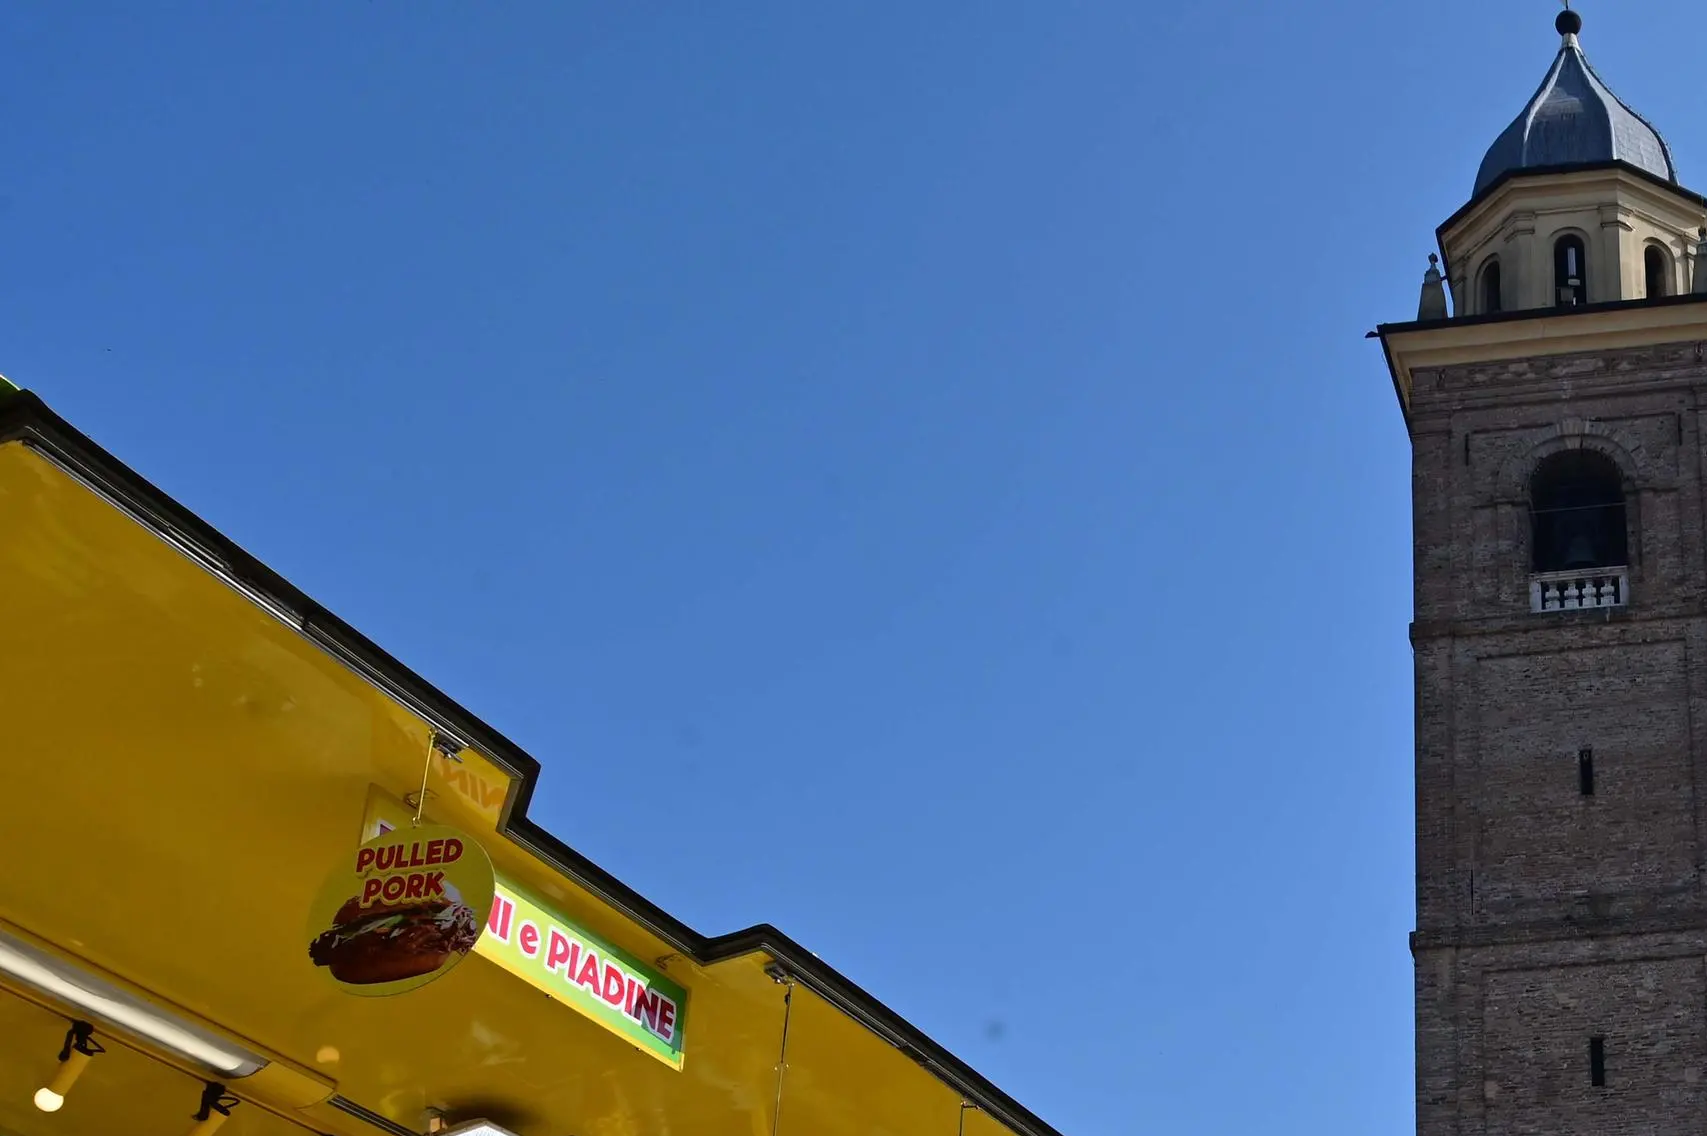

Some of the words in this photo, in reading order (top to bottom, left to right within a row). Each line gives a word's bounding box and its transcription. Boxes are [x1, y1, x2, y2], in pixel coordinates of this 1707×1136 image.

[356, 838, 464, 873] PULLED
[363, 871, 445, 903] PORK
[520, 923, 539, 954] e
[547, 931, 675, 1039] PIADINE
